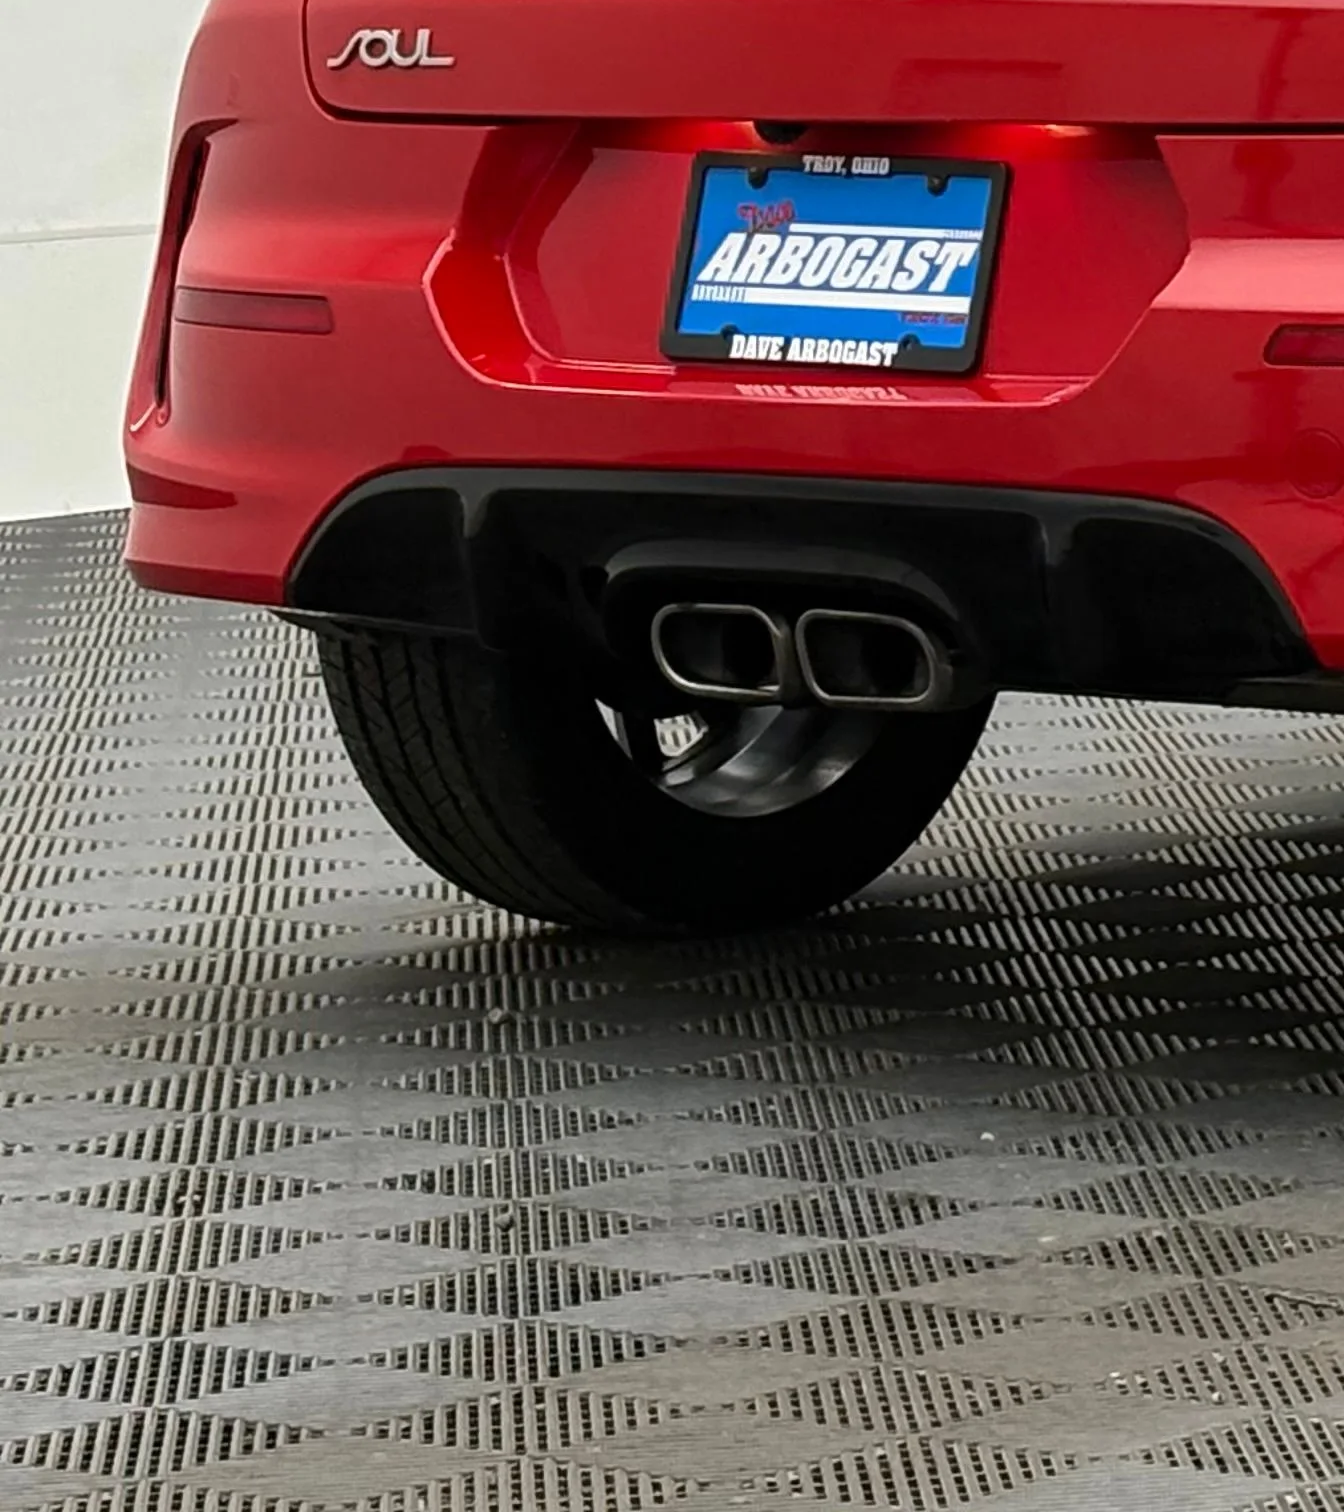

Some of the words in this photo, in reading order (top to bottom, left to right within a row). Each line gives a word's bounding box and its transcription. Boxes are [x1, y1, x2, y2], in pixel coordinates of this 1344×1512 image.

[326, 28, 455, 68] SOUL
[802, 154, 847, 176] TROY,
[851, 156, 890, 175] OHIO
[697, 232, 980, 293] ARBOGAST
[729, 334, 785, 361] DAVE
[786, 337, 899, 367] ARBOGAST
